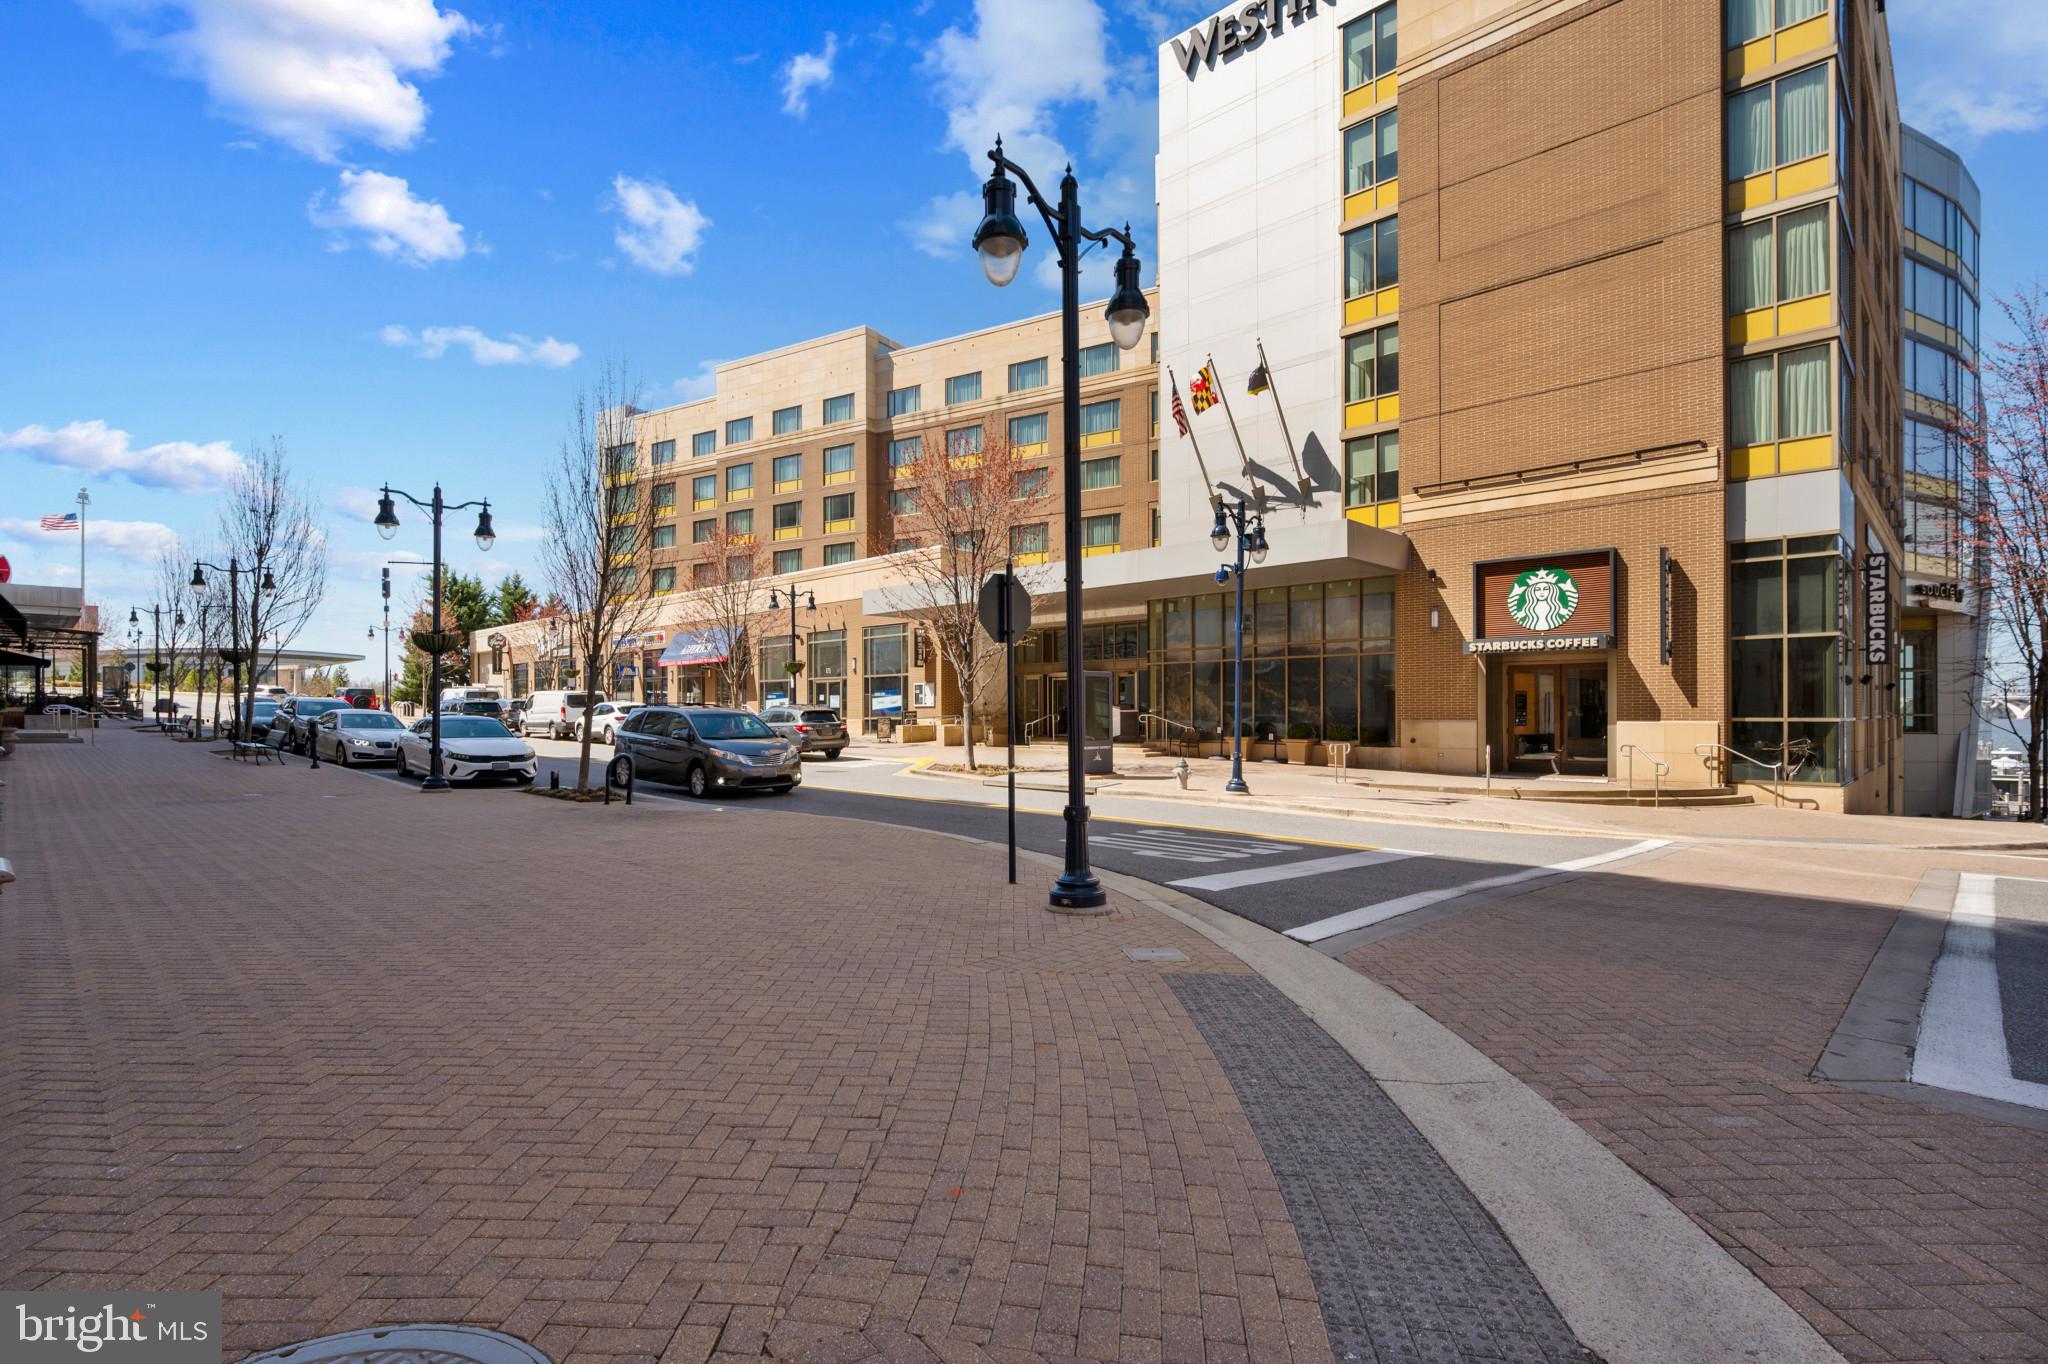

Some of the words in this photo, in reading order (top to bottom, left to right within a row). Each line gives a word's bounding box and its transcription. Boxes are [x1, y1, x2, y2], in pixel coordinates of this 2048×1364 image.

[1170, 0, 1311, 73] WESTI
[1469, 639, 1545, 653] STARBUCKS
[1546, 637, 1599, 650] COFFEE
[1868, 555, 1886, 664] STARBUCKS
